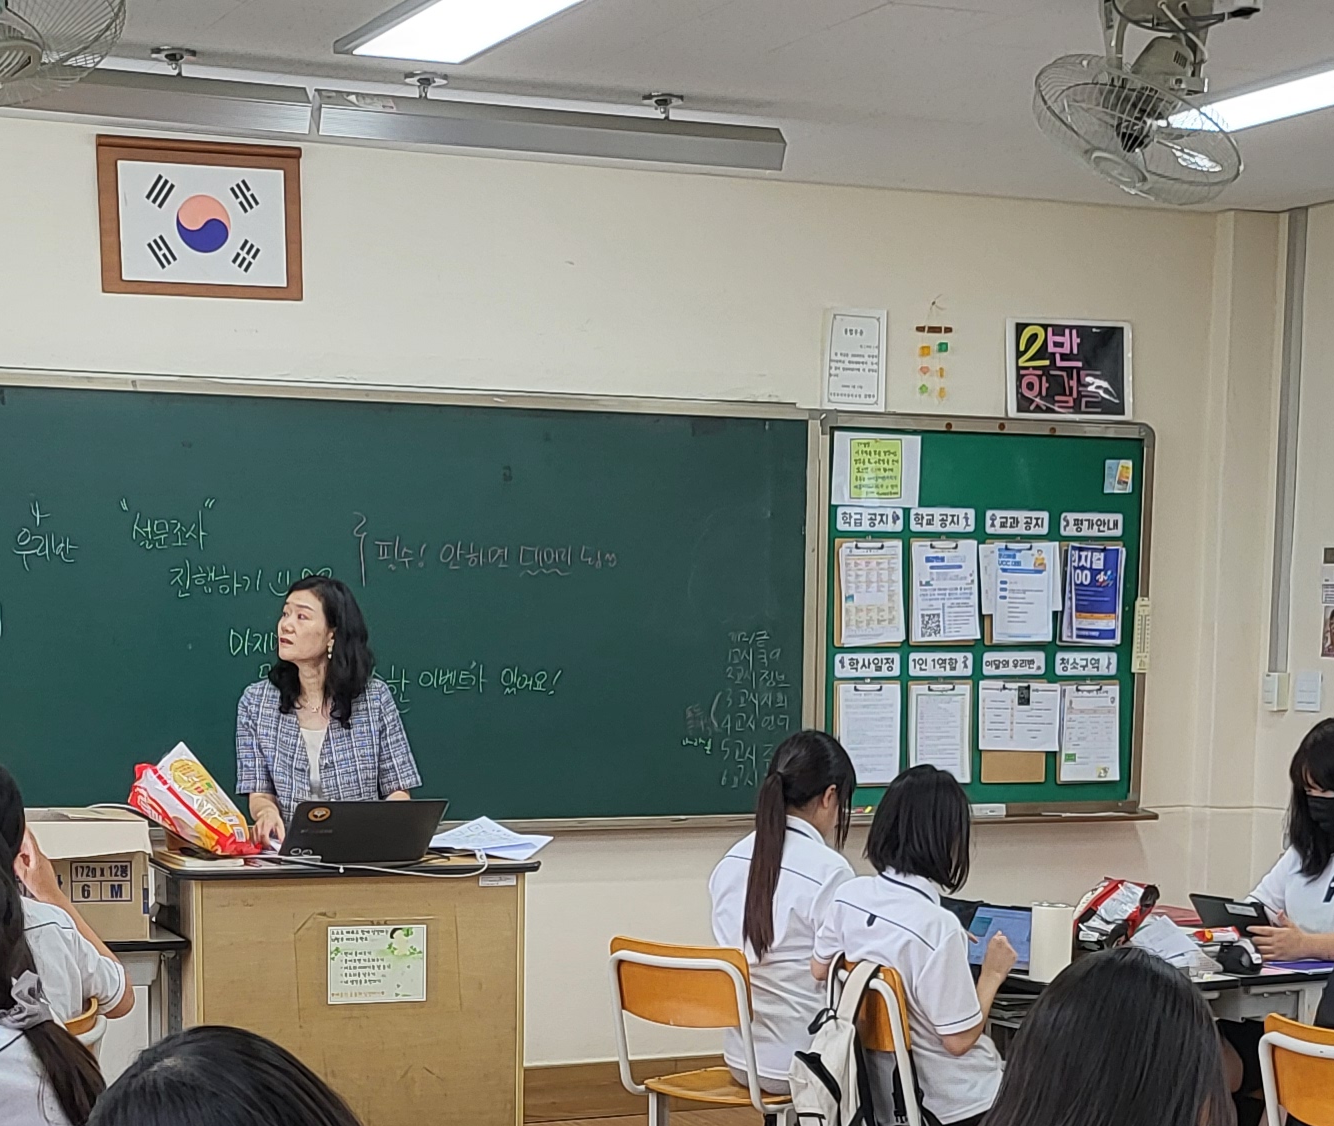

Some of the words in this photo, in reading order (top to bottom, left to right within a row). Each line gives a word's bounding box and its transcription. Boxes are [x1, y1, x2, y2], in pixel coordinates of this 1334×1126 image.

[1018, 325, 1083, 367] 2반
[30, 500, 51, 527] 4
[841, 511, 863, 527] 학급
[867, 513, 889, 528] 공지
[913, 512, 935, 527] 학교
[938, 513, 960, 528] 공지
[999, 516, 1020, 529] 교과
[1023, 517, 1044, 531] 공지
[1073, 518, 1118, 533] 평가안내
[12, 528, 79, 572] 우리반
[374, 536, 427, 569] 필수!
[169, 559, 263, 598] 진행하기
[848, 657, 895, 672] 학사일정
[912, 658, 928, 671] 1인
[931, 658, 958, 672] 1역할
[1059, 657, 1101, 672] 청소구역
[501, 666, 562, 695] 있어요!
[74, 864, 97, 878] 172g
[81, 884, 91, 899] 6
[110, 884, 123, 899] M
